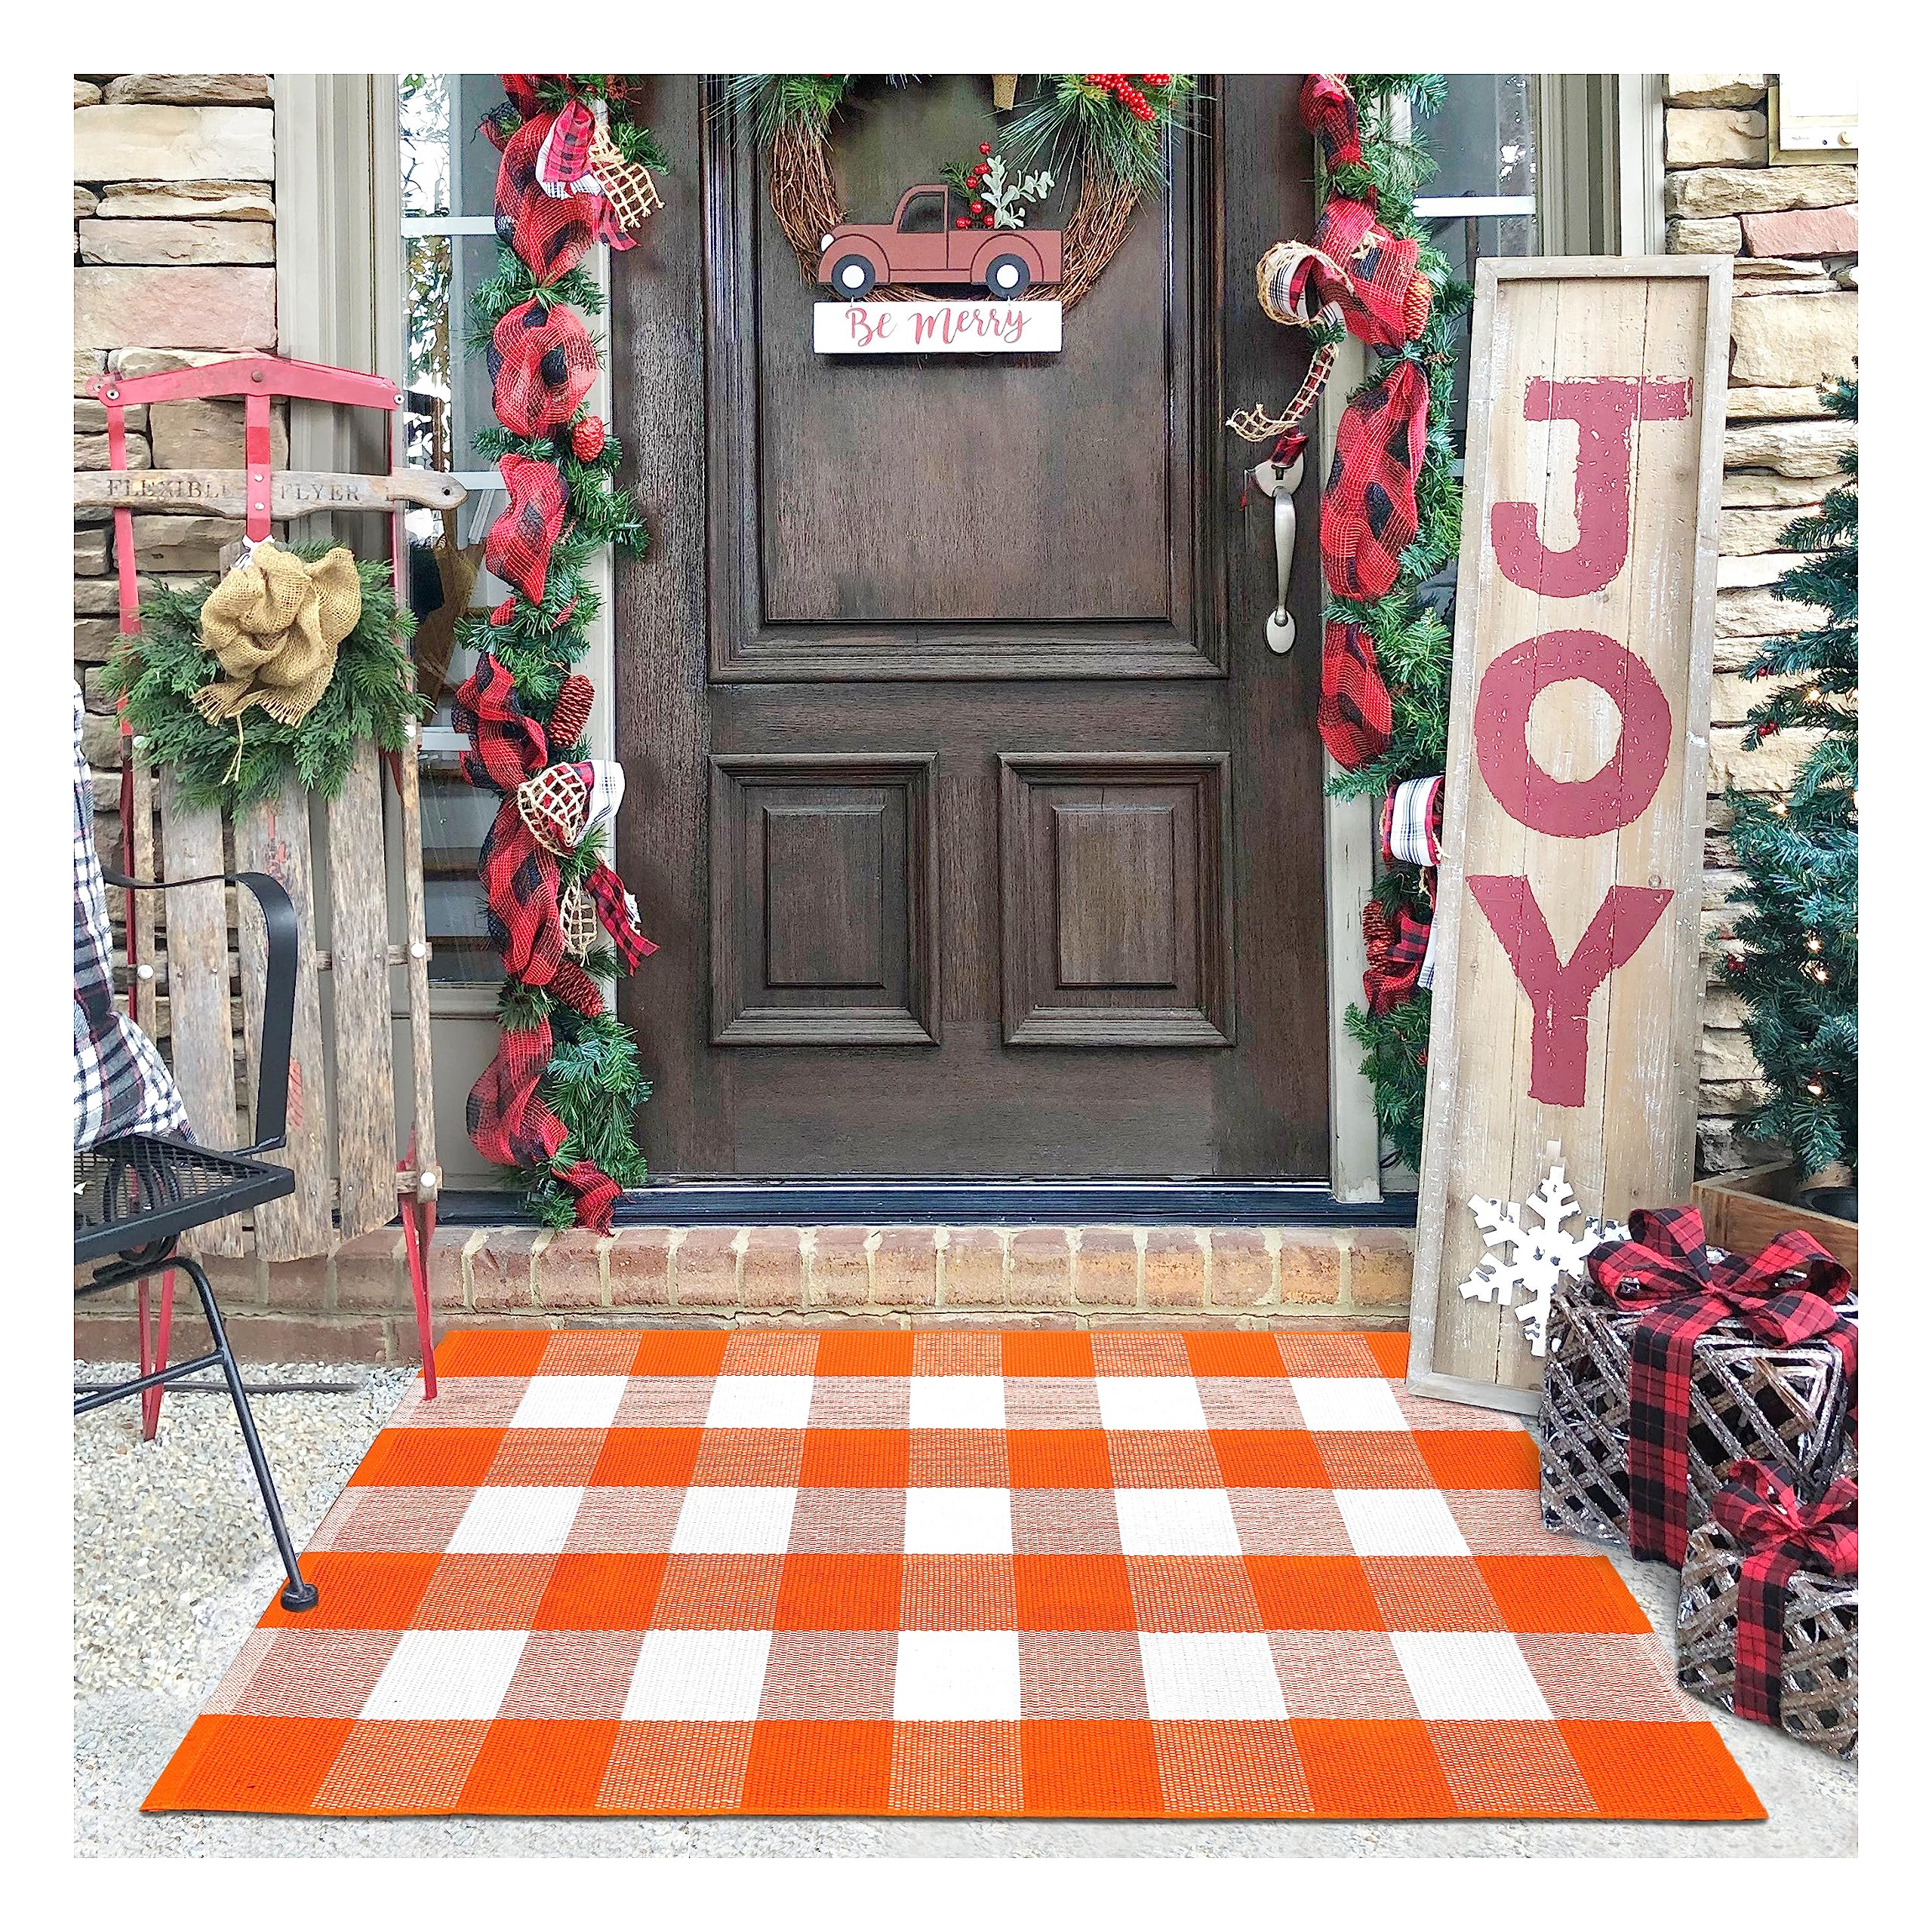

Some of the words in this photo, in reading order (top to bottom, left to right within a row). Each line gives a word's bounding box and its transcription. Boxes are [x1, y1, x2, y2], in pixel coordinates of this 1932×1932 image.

[844, 307, 897, 347] Be
[280, 482, 361, 501] FLYER
[1466, 375, 1694, 1108] JOY
